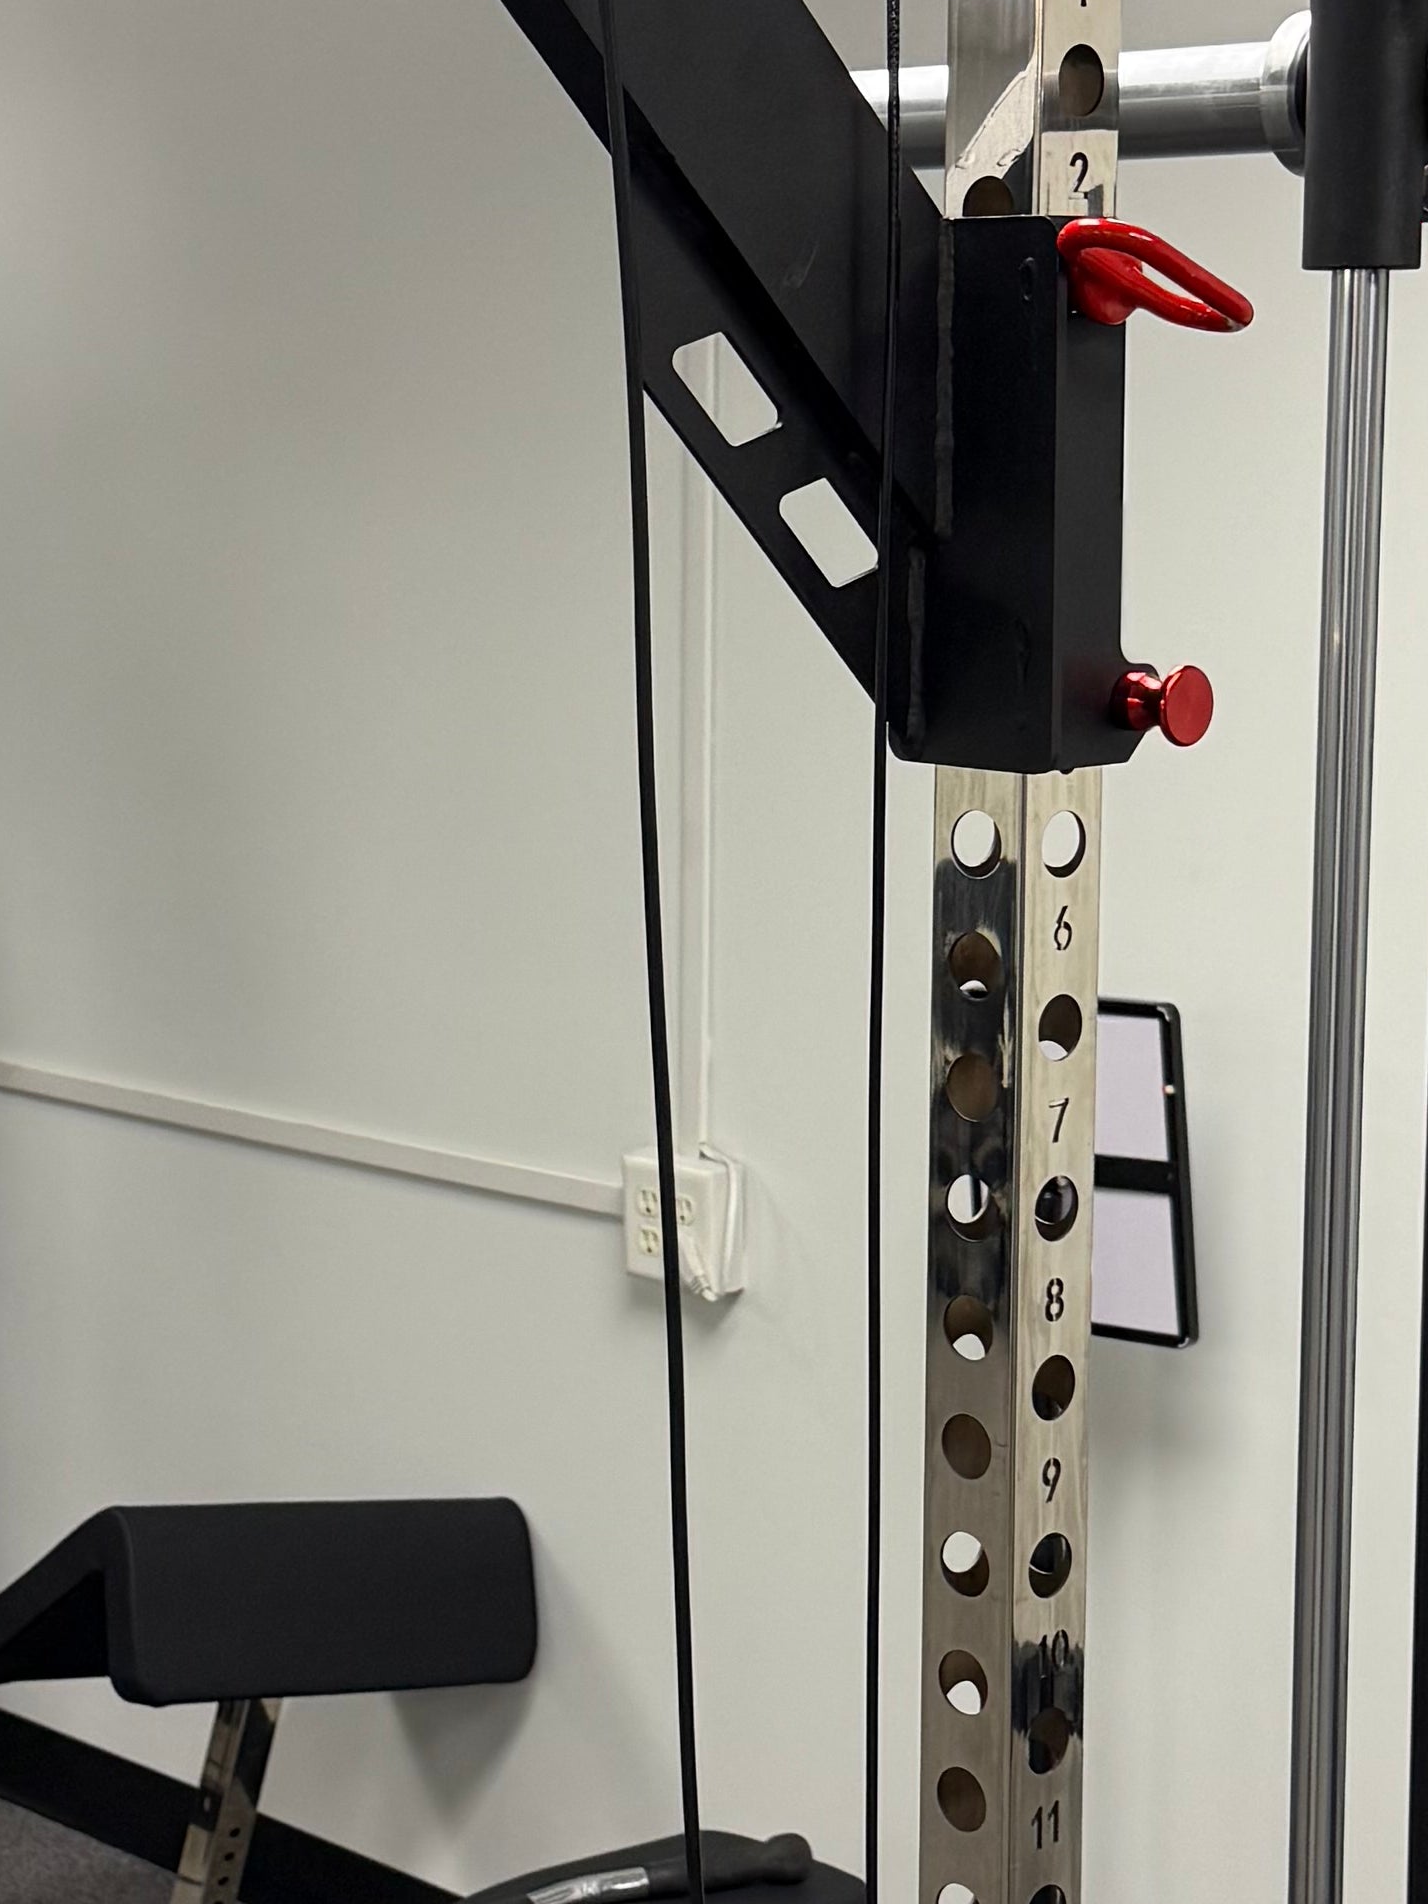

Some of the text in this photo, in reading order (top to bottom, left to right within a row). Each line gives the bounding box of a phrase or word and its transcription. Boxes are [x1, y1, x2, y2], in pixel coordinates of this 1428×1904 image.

[1069, 152, 1089, 193] 2
[1054, 904, 1072, 951] 6
[1048, 1097, 1069, 1144] 7
[1044, 1277, 1065, 1323] 8
[1041, 1456, 1062, 1504] 9
[1030, 1799, 1060, 1850] 11
